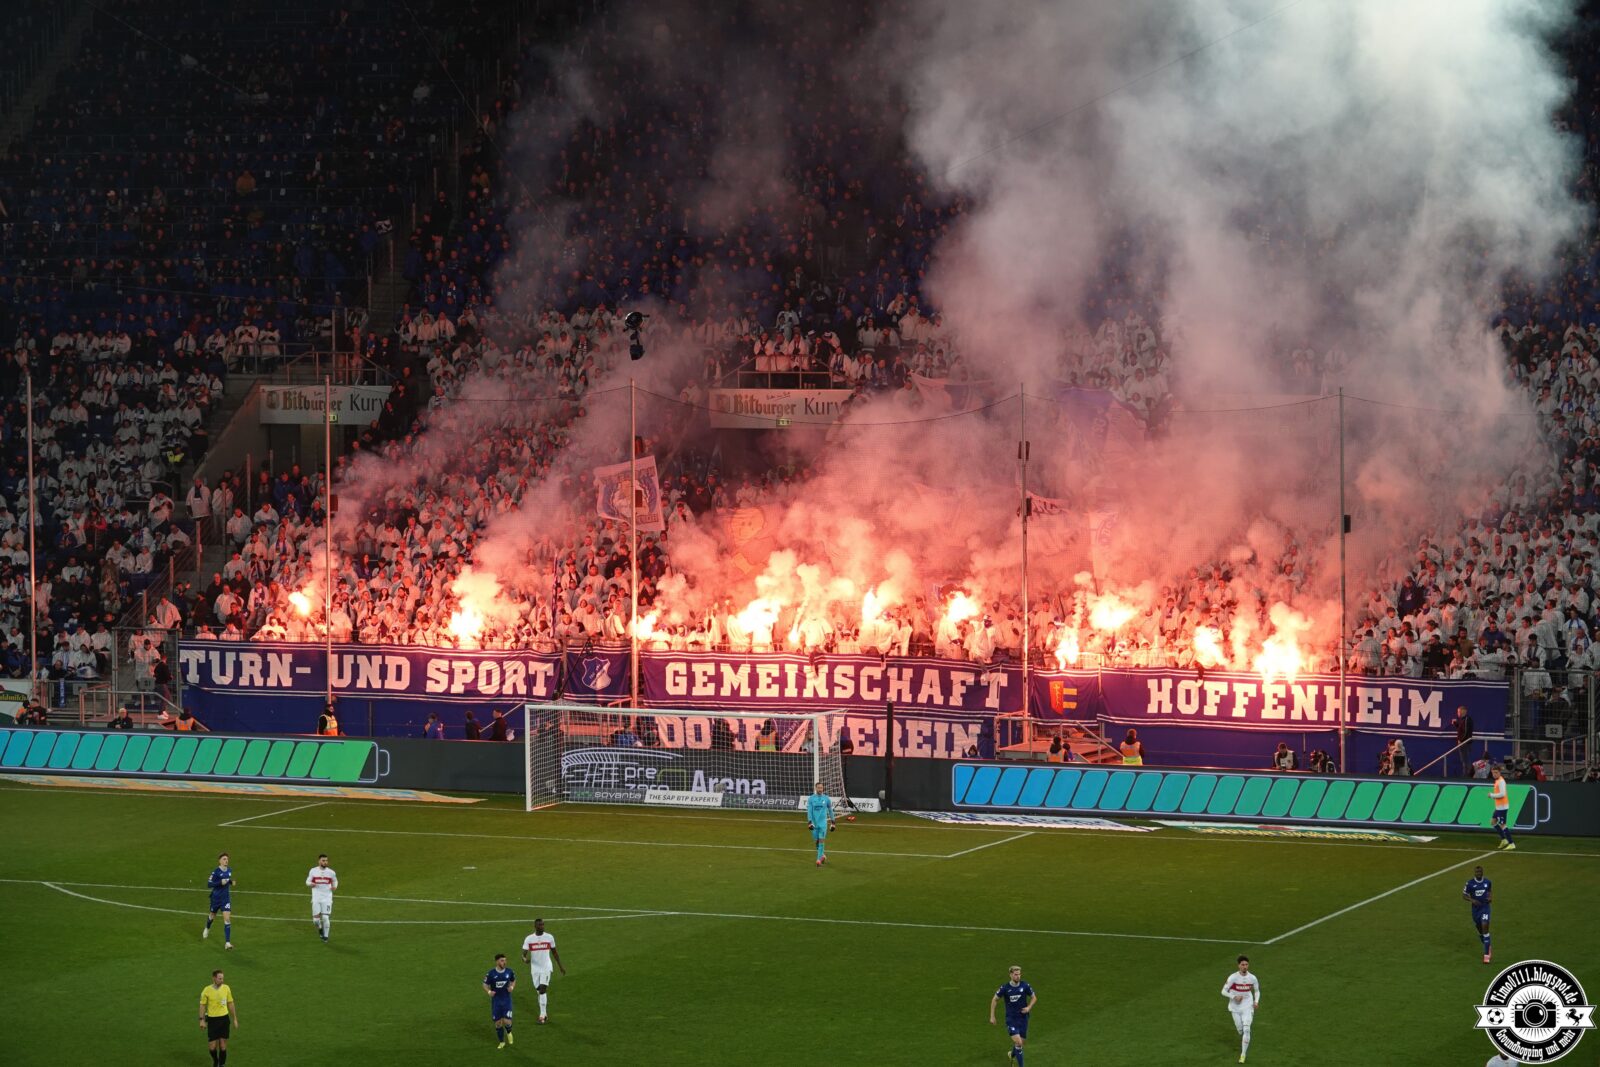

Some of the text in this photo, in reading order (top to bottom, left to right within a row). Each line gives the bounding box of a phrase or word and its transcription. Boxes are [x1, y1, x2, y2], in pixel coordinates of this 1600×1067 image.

[282, 391, 342, 413] Bitburer
[351, 394, 387, 411] Kurv
[734, 393, 796, 417] Bitburger
[178, 650, 311, 687] TURN-
[331, 654, 410, 691] UND
[426, 658, 554, 697] SPORT
[665, 661, 1008, 710] GEMEINSCHAFT
[1147, 678, 1443, 728] HOFFENHEIM
[817, 716, 982, 758] VEREIN
[624, 767, 657, 782] pre
[594, 791, 641, 799] sovanta
[746, 797, 795, 806] sovanta
